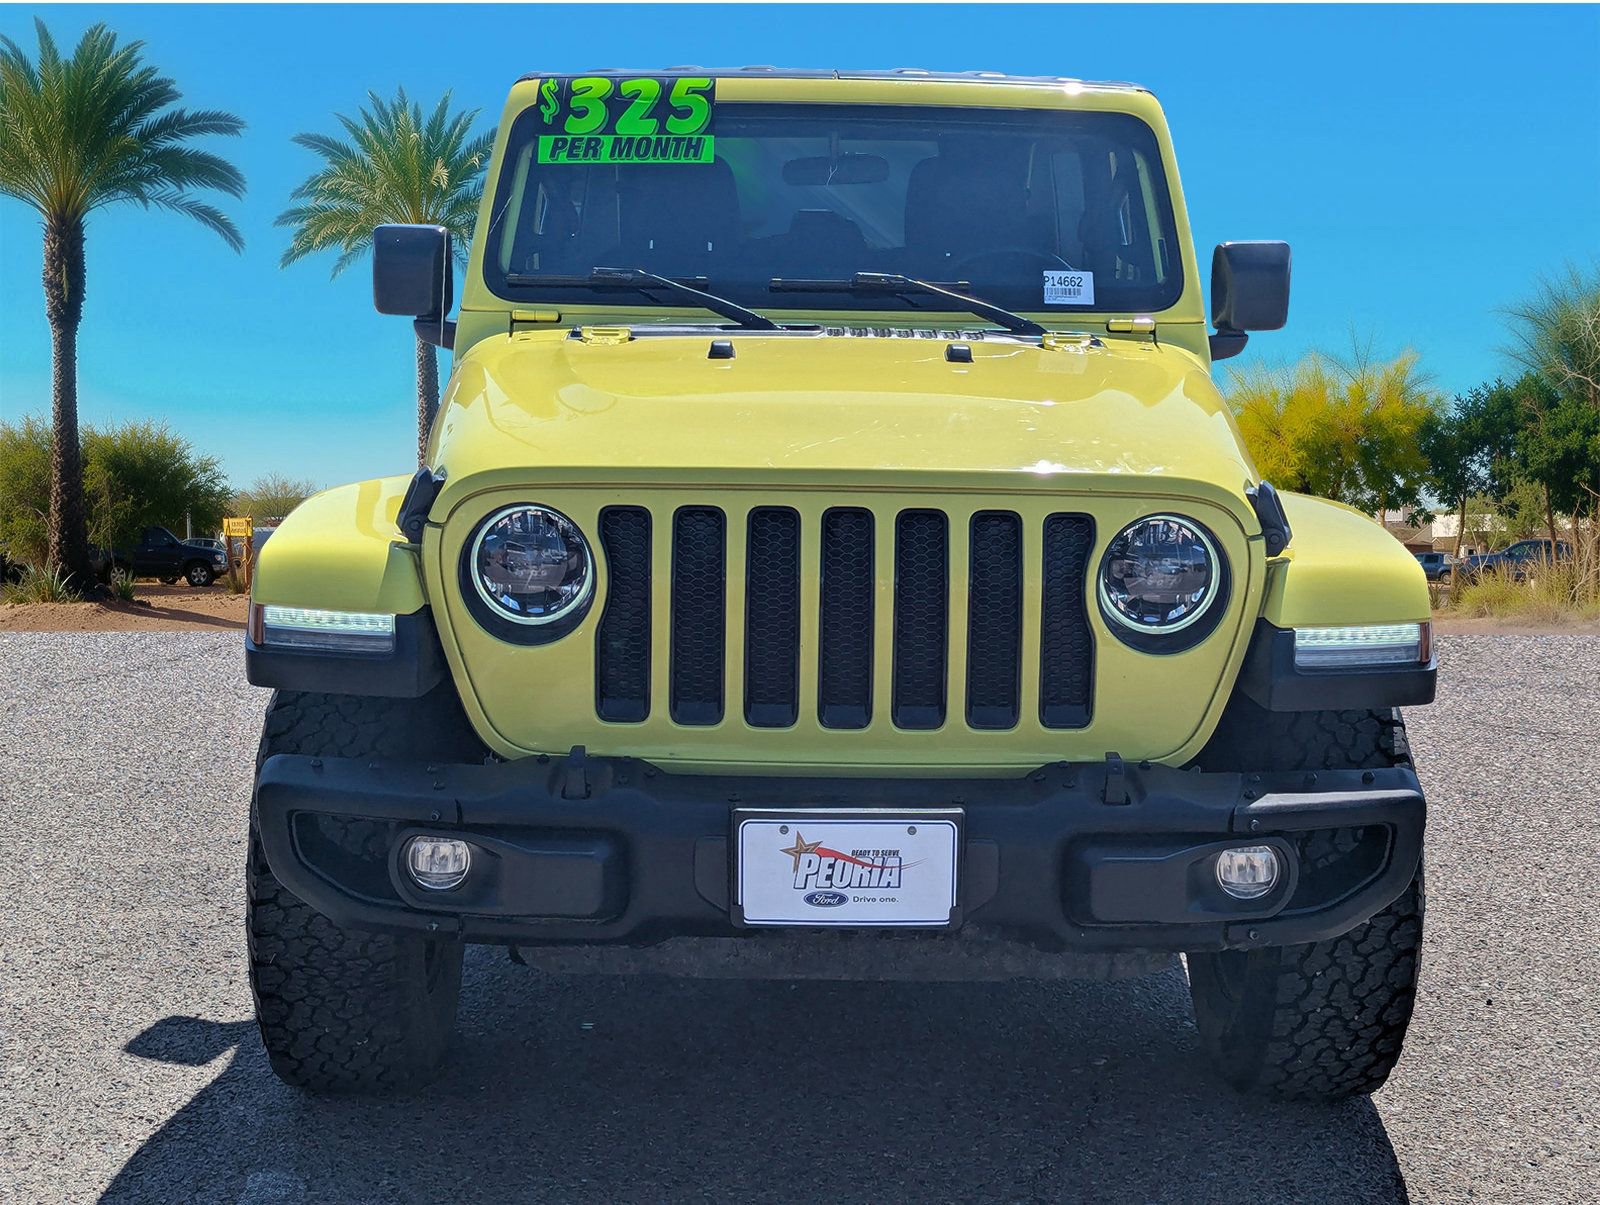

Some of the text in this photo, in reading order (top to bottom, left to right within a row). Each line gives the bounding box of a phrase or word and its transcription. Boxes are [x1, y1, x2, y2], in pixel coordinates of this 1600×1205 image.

[539, 77, 715, 135] $325
[549, 136, 706, 161] PER MONTH
[1043, 275, 1083, 287] P14662
[851, 849, 900, 857] READY TO SERVE
[793, 853, 902, 889] PEORIA
[812, 894, 840, 906] Ford
[852, 895, 877, 903] Drive
